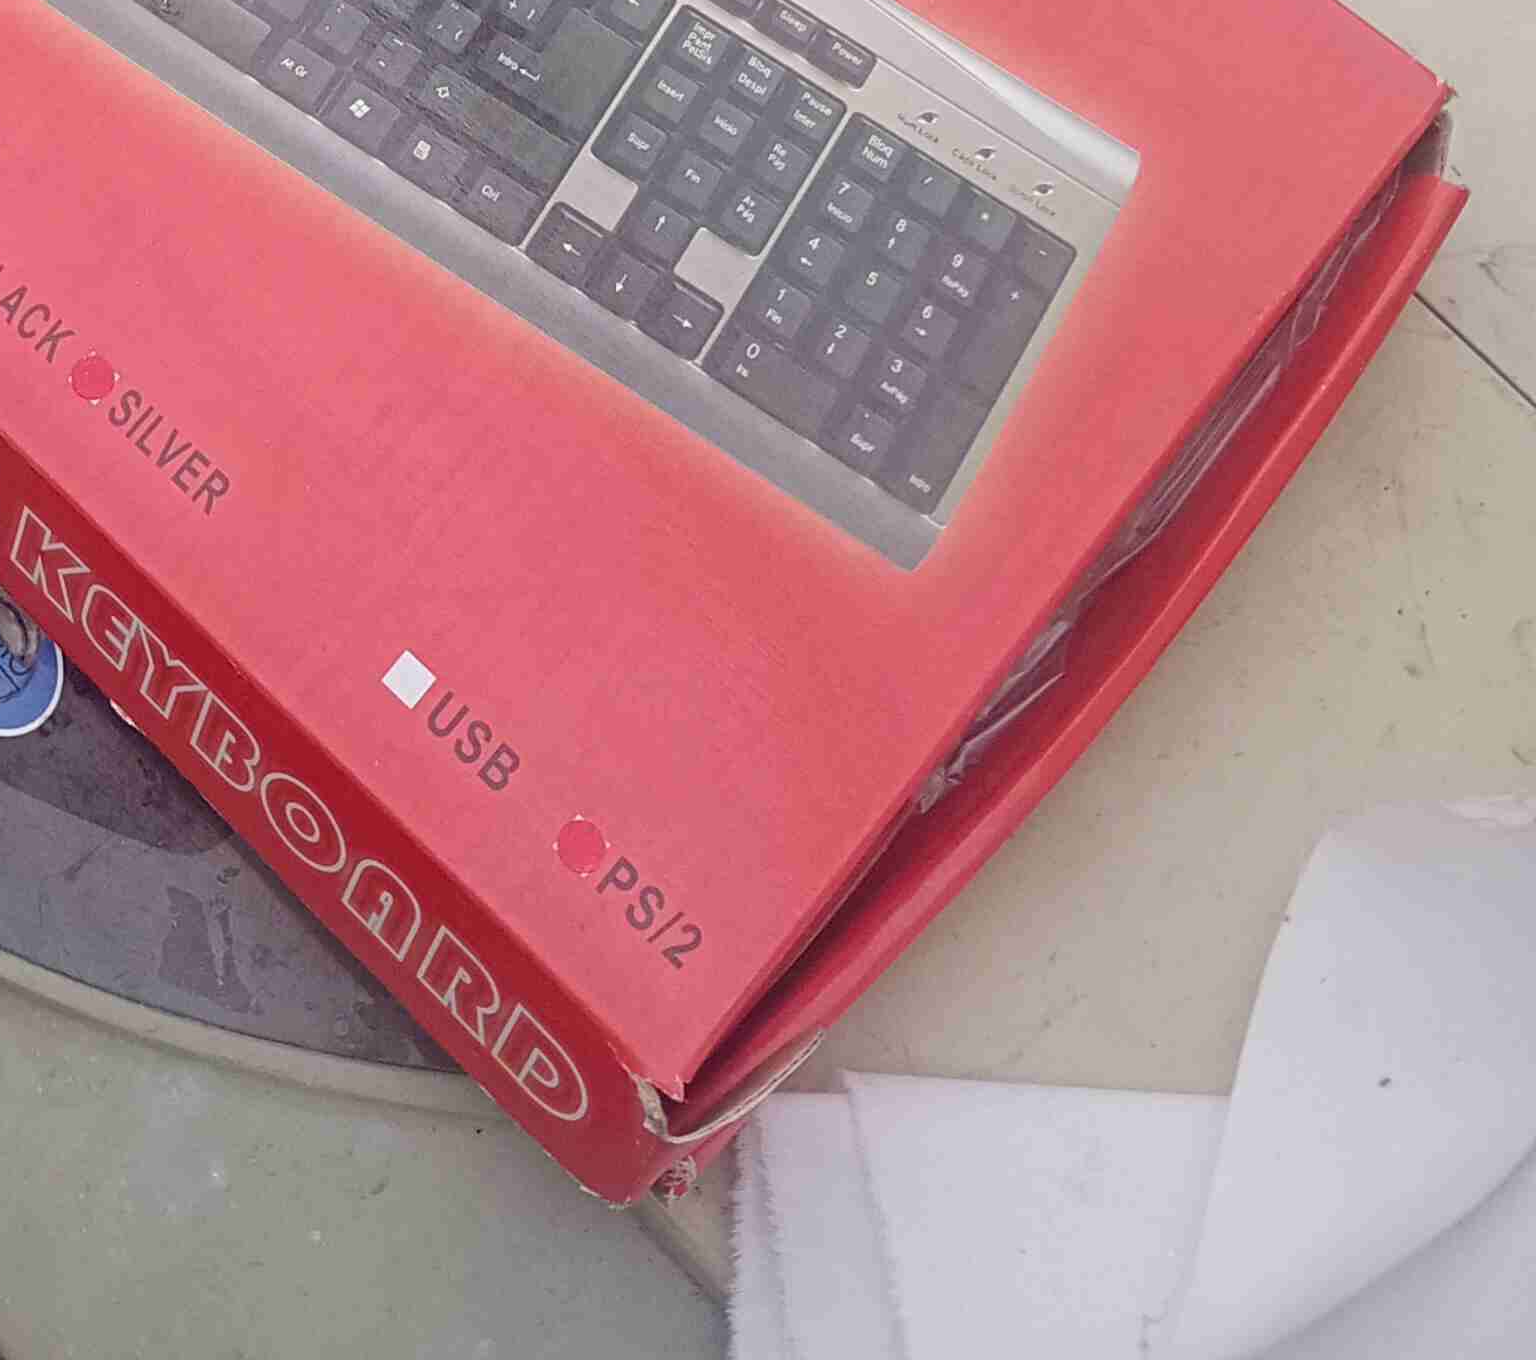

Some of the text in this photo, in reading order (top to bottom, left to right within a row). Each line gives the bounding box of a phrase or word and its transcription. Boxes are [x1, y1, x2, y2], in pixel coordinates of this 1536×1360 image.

[838, 181, 851, 195] 7
[895, 218, 907, 233] 8
[808, 237, 821, 250] 4
[951, 253, 964, 268] 9
[866, 271, 879, 286] 5
[777, 288, 787, 301] 1
[834, 324, 847, 339] 2
[746, 343, 761, 359] 0
[890, 359, 903, 373] 3
[107, 388, 231, 516] SILVER
[426, 690, 522, 792] USB
[9, 505, 590, 1122] KEYBOARD
[595, 855, 704, 970] PS/2
